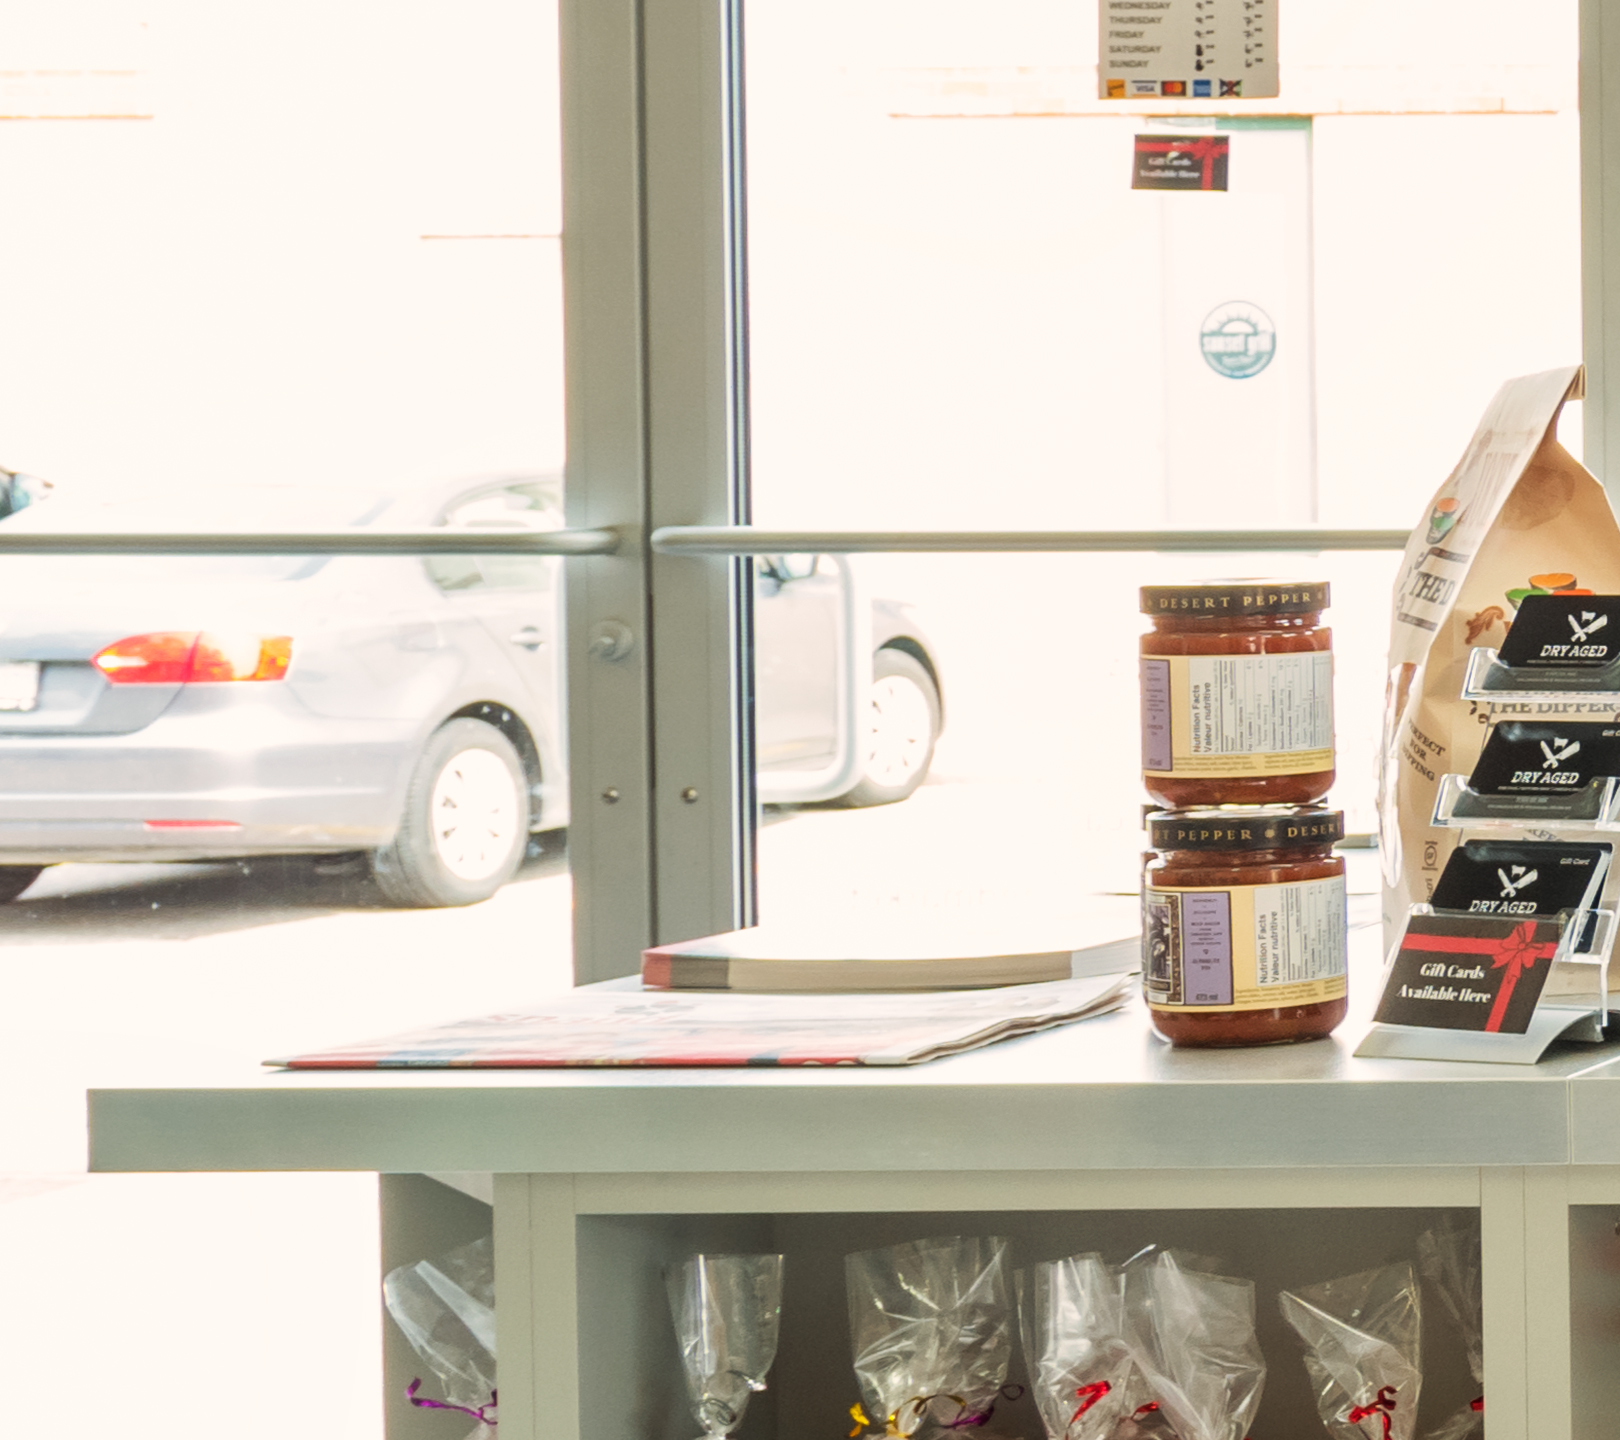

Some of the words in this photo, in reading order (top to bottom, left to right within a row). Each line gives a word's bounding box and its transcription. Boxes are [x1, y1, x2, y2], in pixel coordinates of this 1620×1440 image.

[1109, 1, 1172, 10] WEDNESDAY
[1109, 16, 1163, 24] THURSDAY
[1109, 30, 1145, 39] FRIDAY
[1109, 45, 1162, 53] SATURDAY
[1159, 594, 1231, 609] DESERT
[1243, 592, 1311, 606] PEPPER
[1540, 646, 1566, 658] DRY
[1567, 645, 1607, 658] AGED
[1192, 684, 1201, 707] Facts
[1203, 682, 1212, 722] nutritive
[1192, 710, 1201, 754] Nutrition
[1203, 725, 1212, 754] Valeur
[1410, 739, 1427, 761] FOR
[1177, 828, 1252, 842] PEPPER
[1420, 963, 1444, 977] Gift
[1447, 964, 1485, 980] Cards
[1397, 984, 1457, 1001] Available
[1459, 989, 1491, 1003] Here
